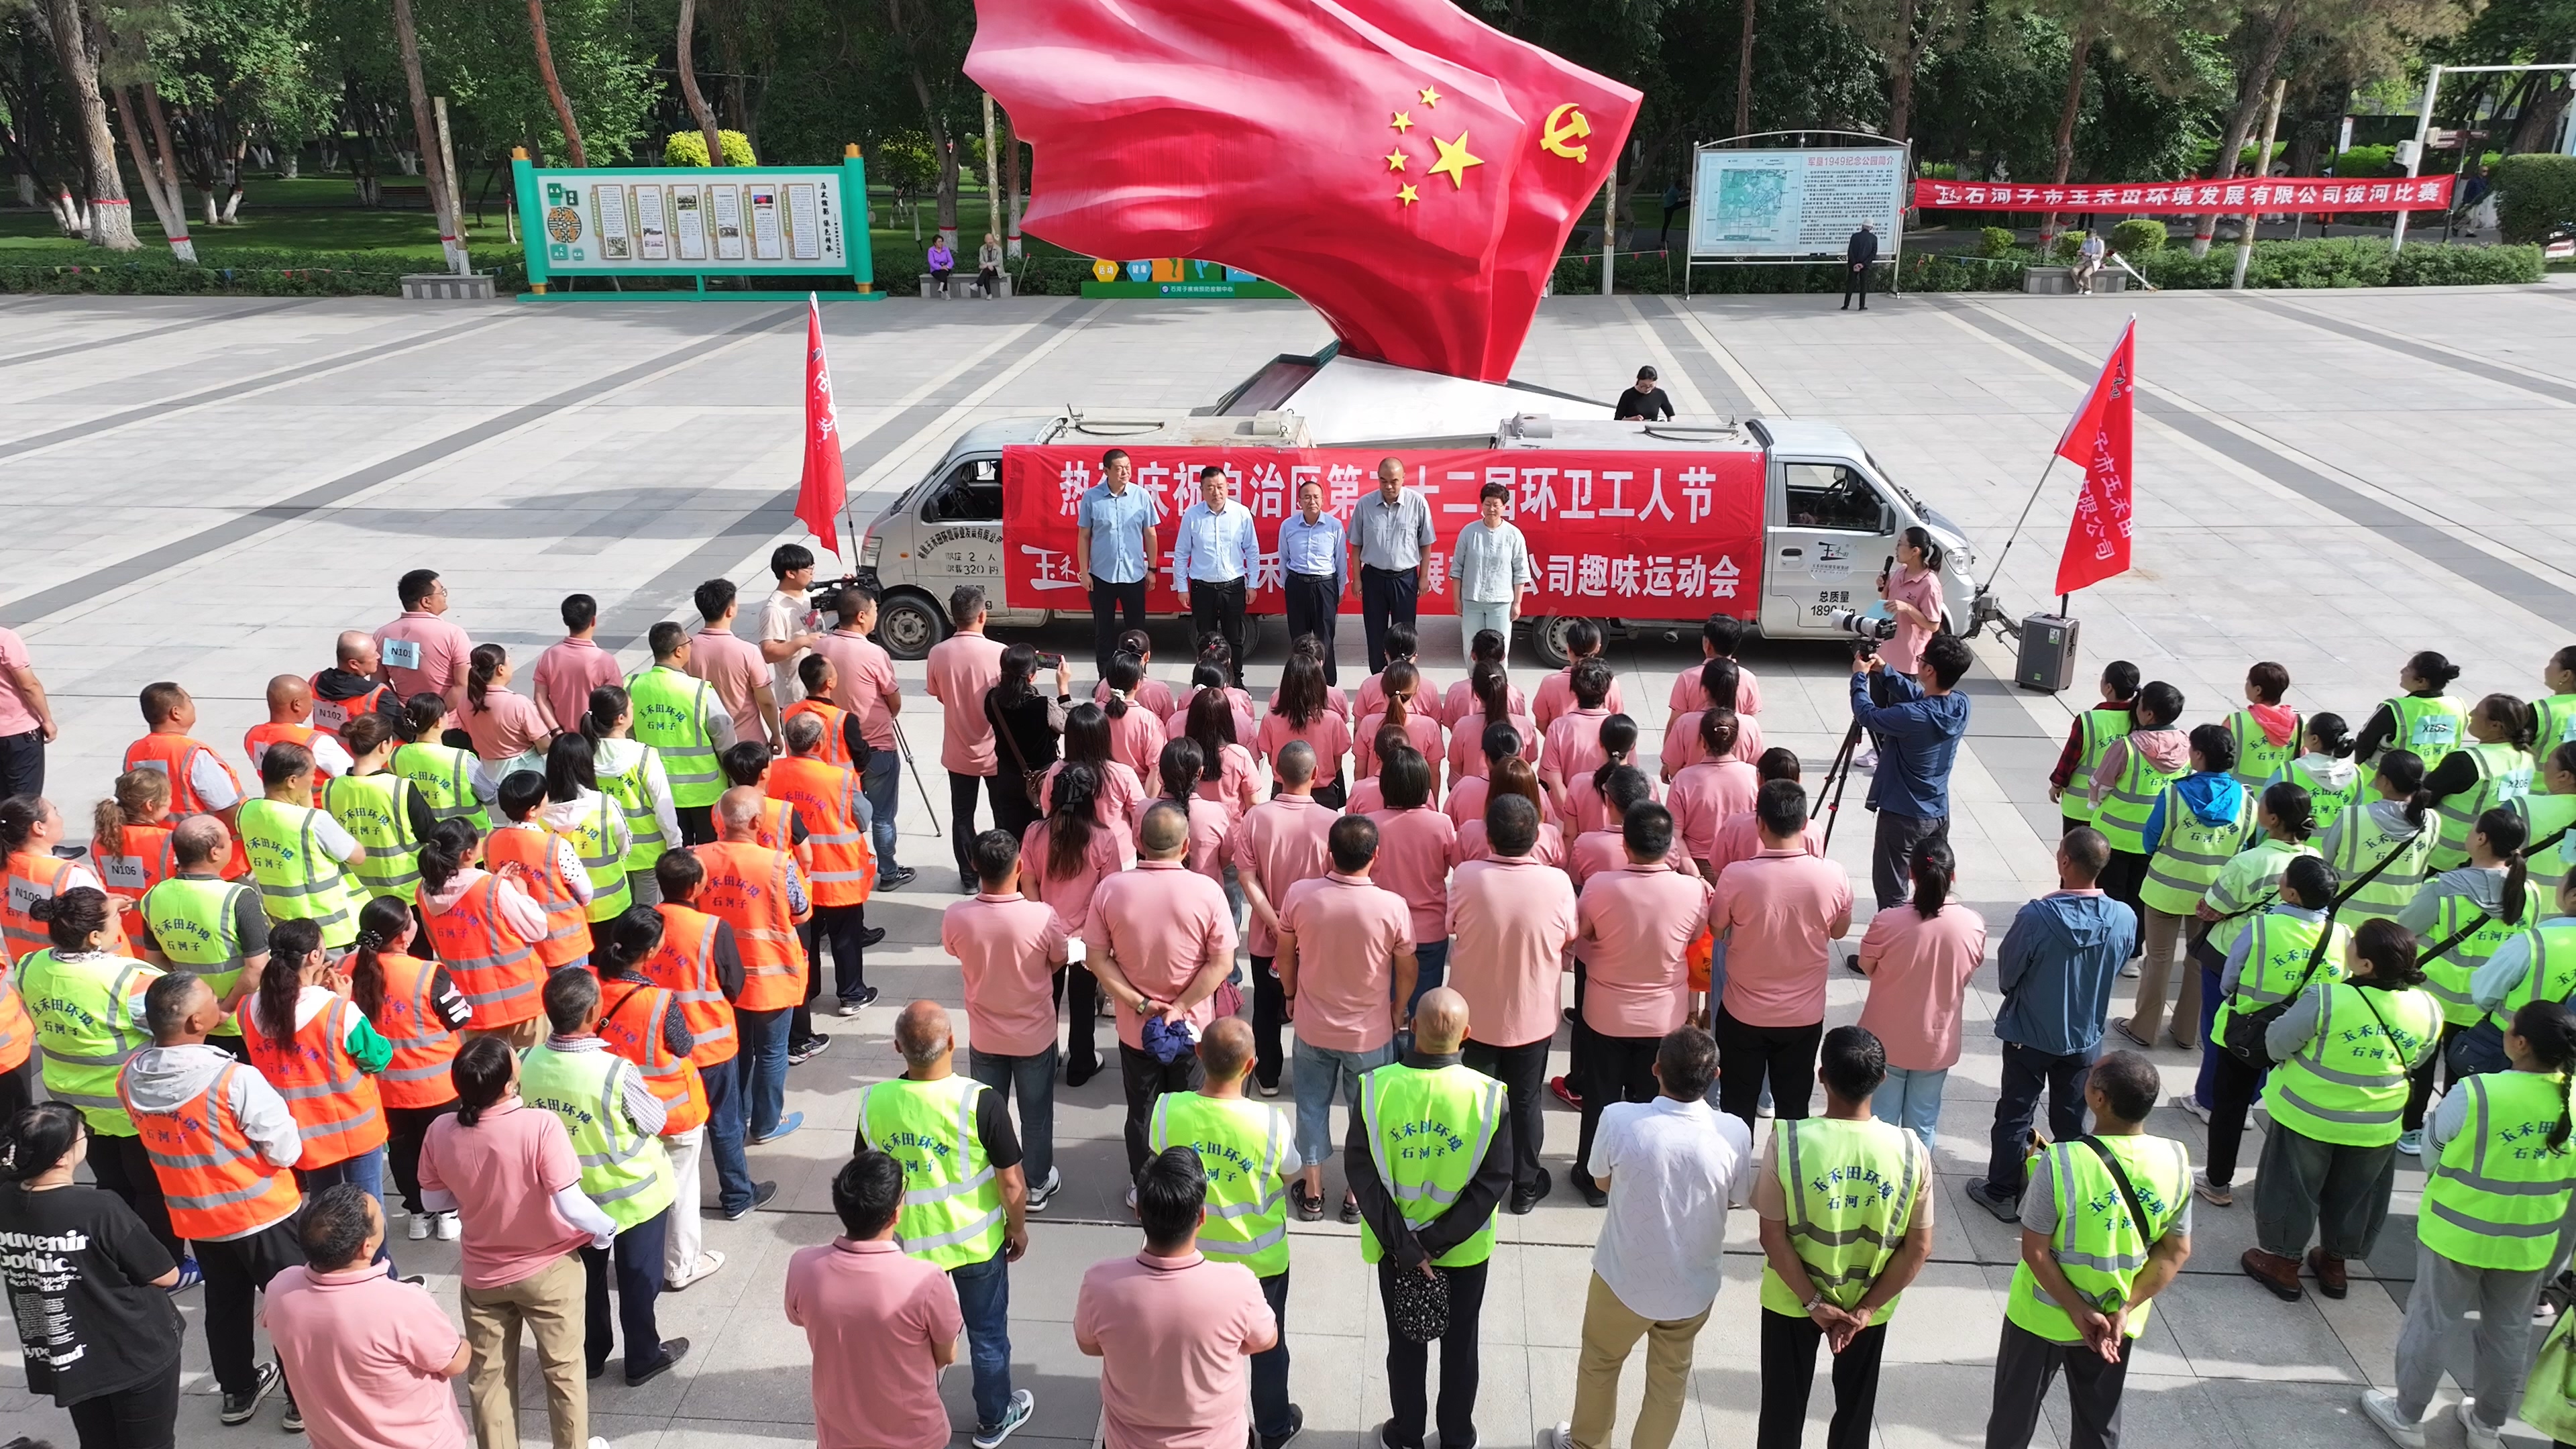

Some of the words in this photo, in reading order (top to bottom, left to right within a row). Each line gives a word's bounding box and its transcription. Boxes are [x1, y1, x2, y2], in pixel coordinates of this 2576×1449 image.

[1808, 156, 1894, 166] 军垦1949纪念公园简介
[1965, 182, 2440, 206] 石河子市玉禾田环境发展有限公司拔河比赛
[1099, 265, 1114, 274] 运动
[969, 552, 975, 561] 2
[988, 553, 996, 561] 人
[1819, 591, 1849, 603] 总质量
[391, 647, 411, 657] N101
[319, 708, 341, 721] N102
[639, 704, 686, 722] 玉禾田环境
[647, 721, 676, 731] 石河子
[407, 771, 451, 790] 禾田环境
[349, 826, 380, 835] 石河子
[254, 857, 283, 869] 石河子
[2375, 851, 2413, 861] 石子
[111, 865, 137, 875] N106
[712, 896, 747, 909] 石河子
[154, 918, 211, 941] 玉禾田环境
[166, 941, 201, 952] 石河子
[31, 997, 94, 1028] 玉禾田环境
[44, 1020, 78, 1036] 石河子
[2339, 1024, 2417, 1050] 玉禾田环境
[146, 1128, 187, 1144] 石河子
[1388, 1119, 1464, 1152] 玉禾田环境
[881, 1132, 951, 1157] 玉禾田环境
[1189, 1141, 1254, 1174] 禾田环境
[1400, 1145, 1445, 1160] 石河子
[1207, 1168, 1237, 1182] 河子
[1809, 1165, 1894, 1201] 玉禾田环境
[1826, 1195, 1876, 1210] 石河子
[2086, 1186, 2165, 1216] 玉禾环境
